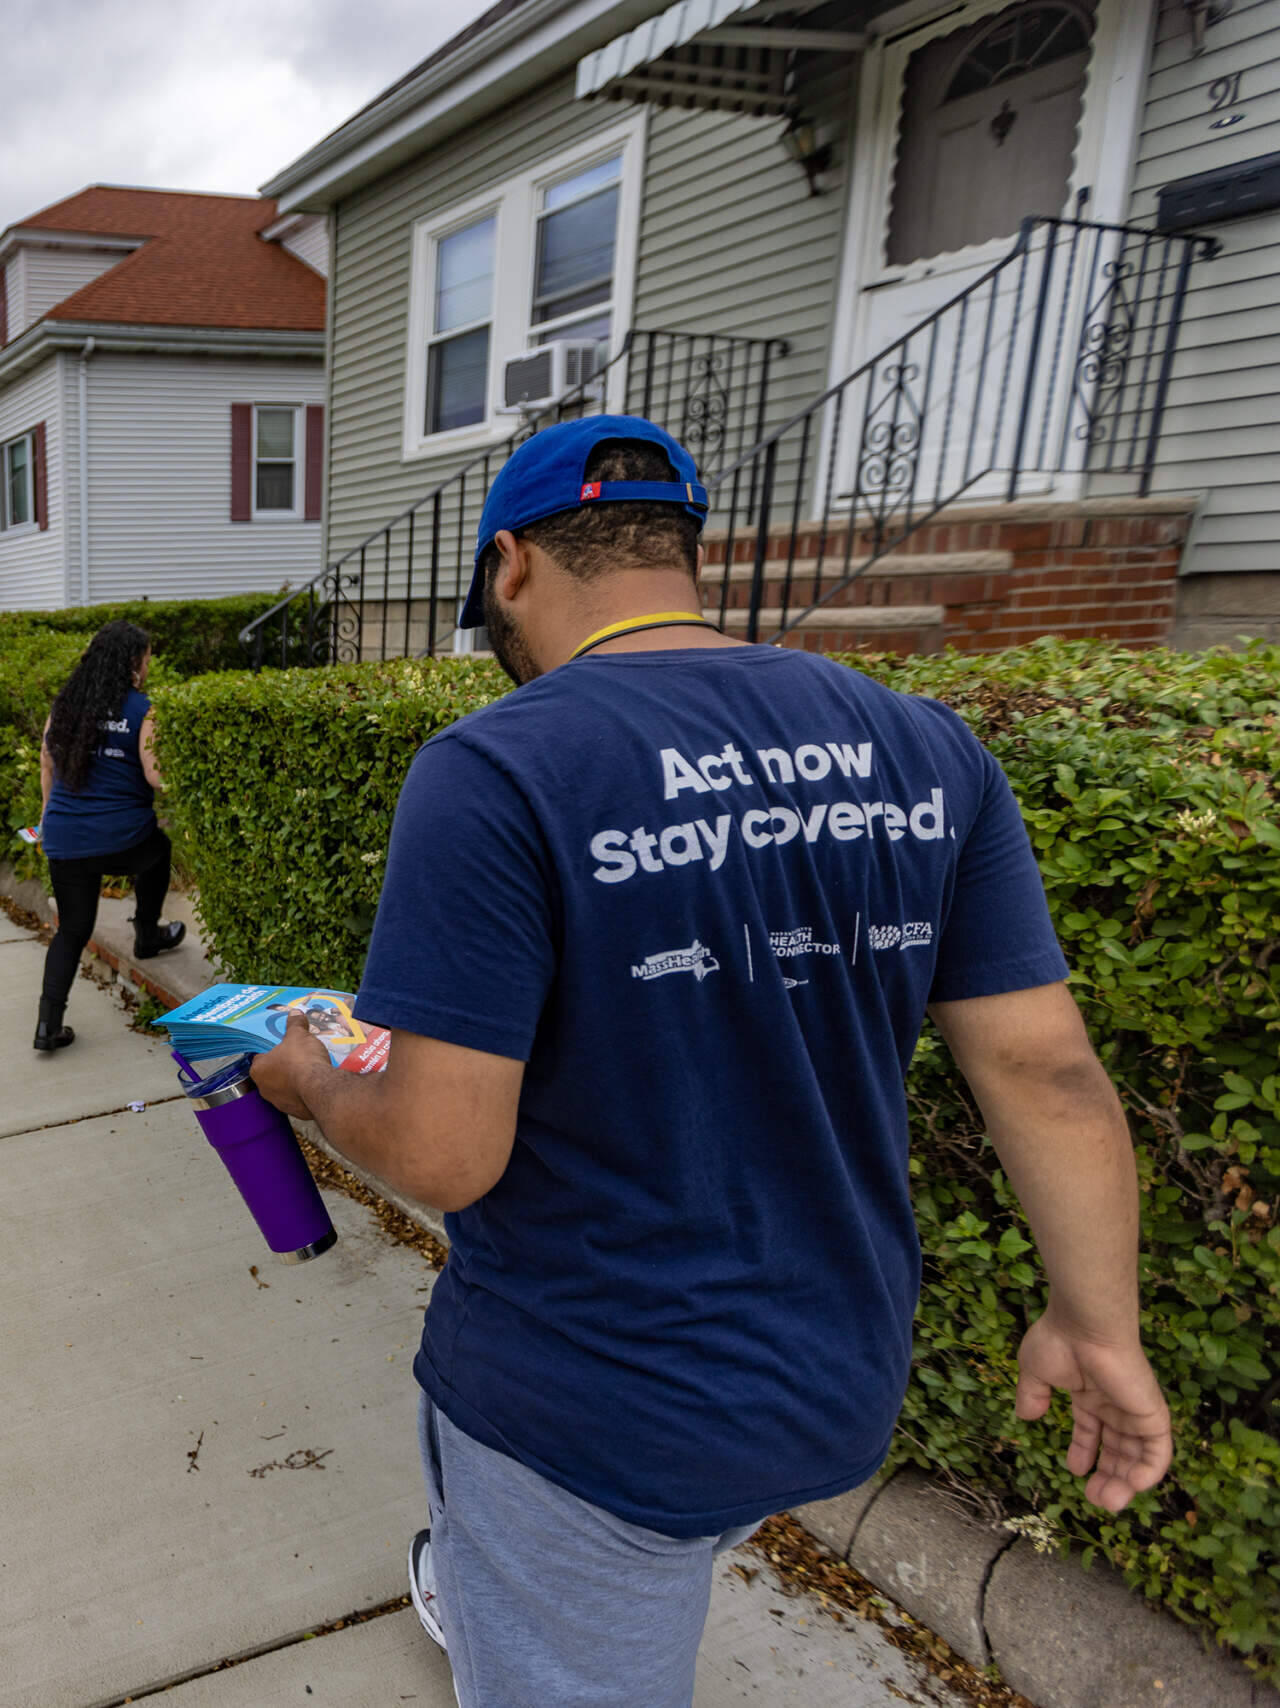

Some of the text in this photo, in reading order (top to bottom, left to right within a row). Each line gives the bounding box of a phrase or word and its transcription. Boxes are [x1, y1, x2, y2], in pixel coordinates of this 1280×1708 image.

[660, 742, 872, 800] Act now
[589, 787, 956, 884] Stay covered.
